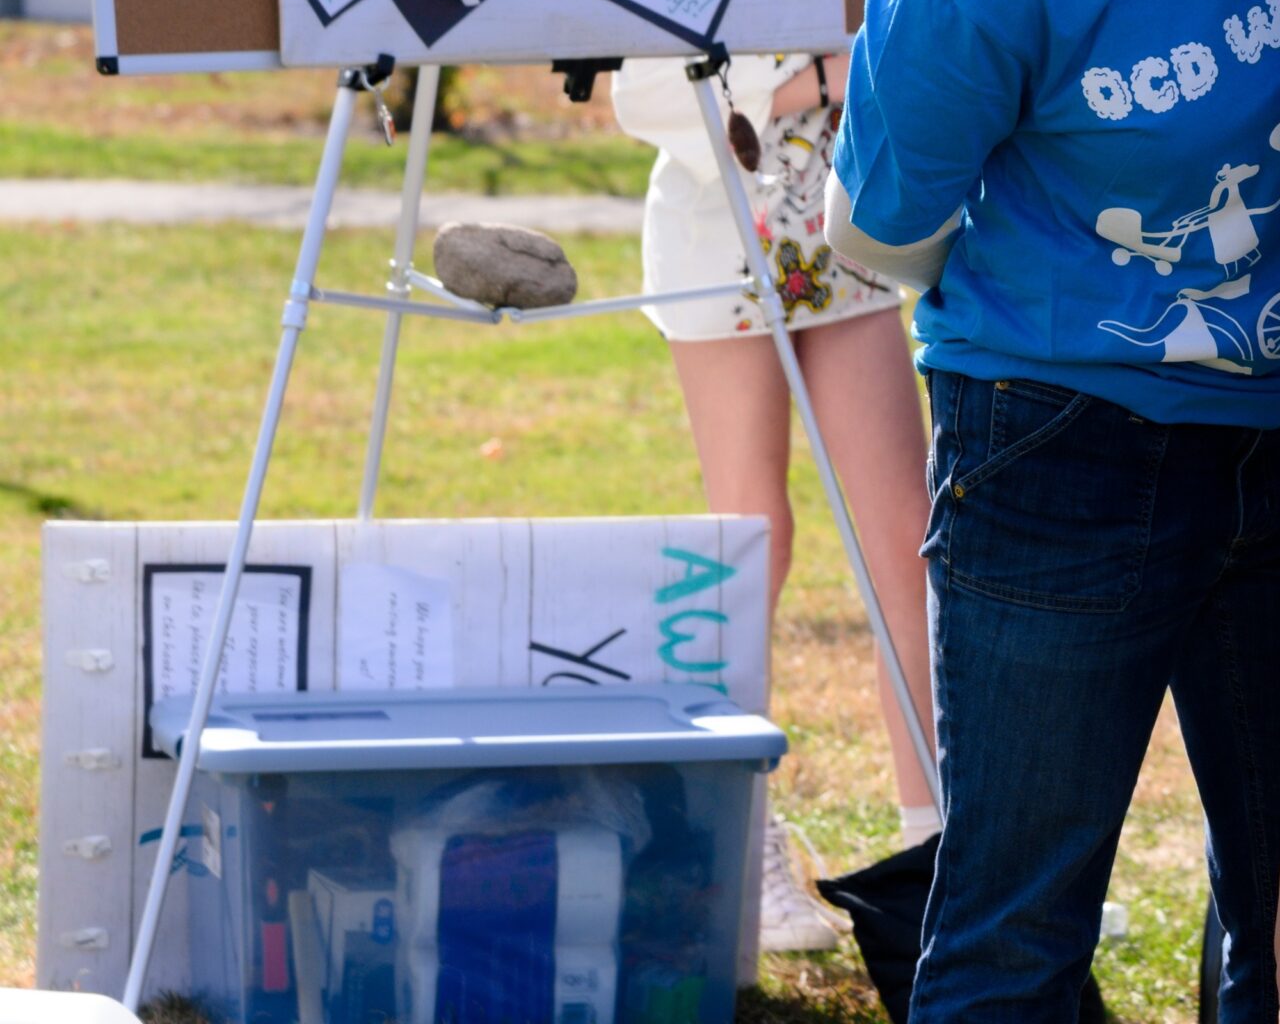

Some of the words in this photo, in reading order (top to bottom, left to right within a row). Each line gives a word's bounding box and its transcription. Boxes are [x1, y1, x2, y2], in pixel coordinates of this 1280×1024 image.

[1081, 42, 1218, 121] OCD
[278, 611, 287, 632] are
[278, 637, 289, 688] welcome
